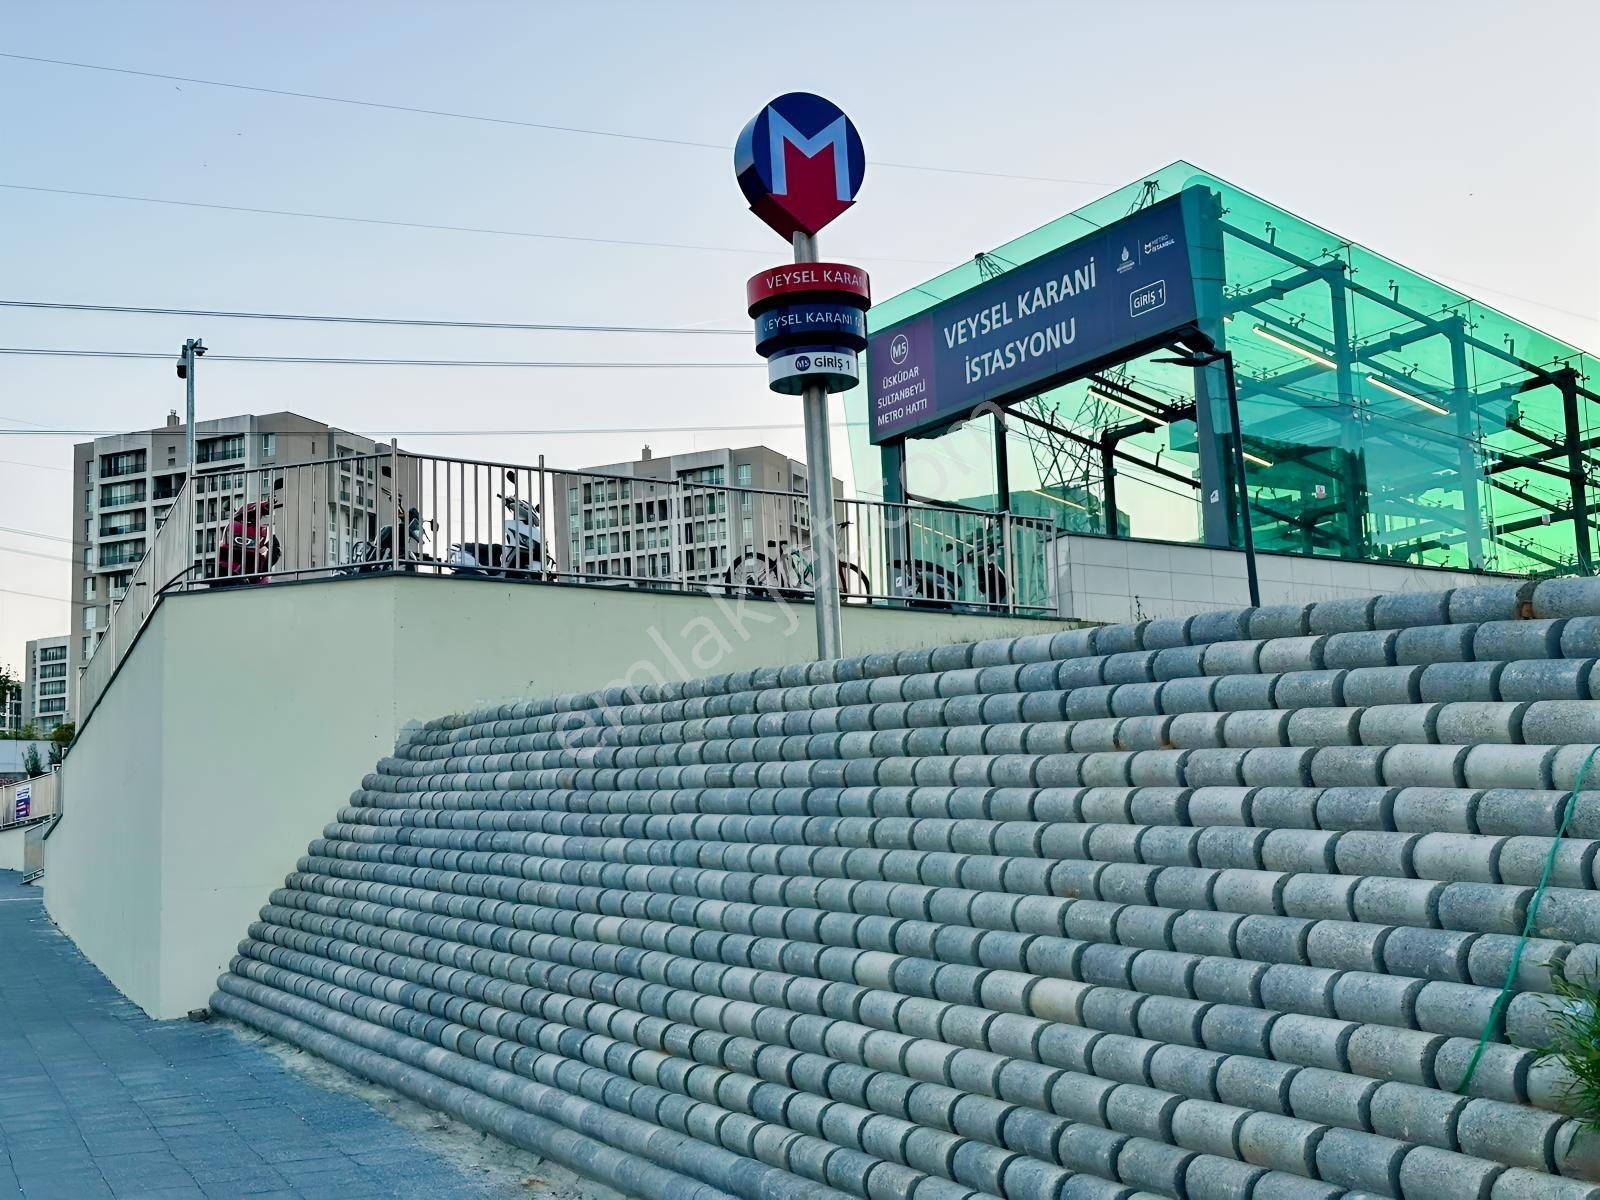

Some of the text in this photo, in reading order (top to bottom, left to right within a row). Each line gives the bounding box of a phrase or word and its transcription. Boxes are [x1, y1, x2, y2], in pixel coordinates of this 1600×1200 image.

[768, 105, 851, 202] M
[766, 270, 819, 289] VEYSEL
[943, 256, 1096, 349] VEYSEL KARANİ
[1133, 288, 1163, 309] GİRİŞ 1
[763, 313, 803, 332] VEYSEL
[892, 341, 907, 359] M5
[965, 317, 1076, 385] İSTASYONU
[814, 355, 843, 371] GİRİŞ
[845, 360, 850, 370] 1
[882, 366, 920, 390] ÜSKÜDAR
[877, 378, 926, 409] SULTANBEYLİ
[877, 398, 928, 427] METRO HATTI
